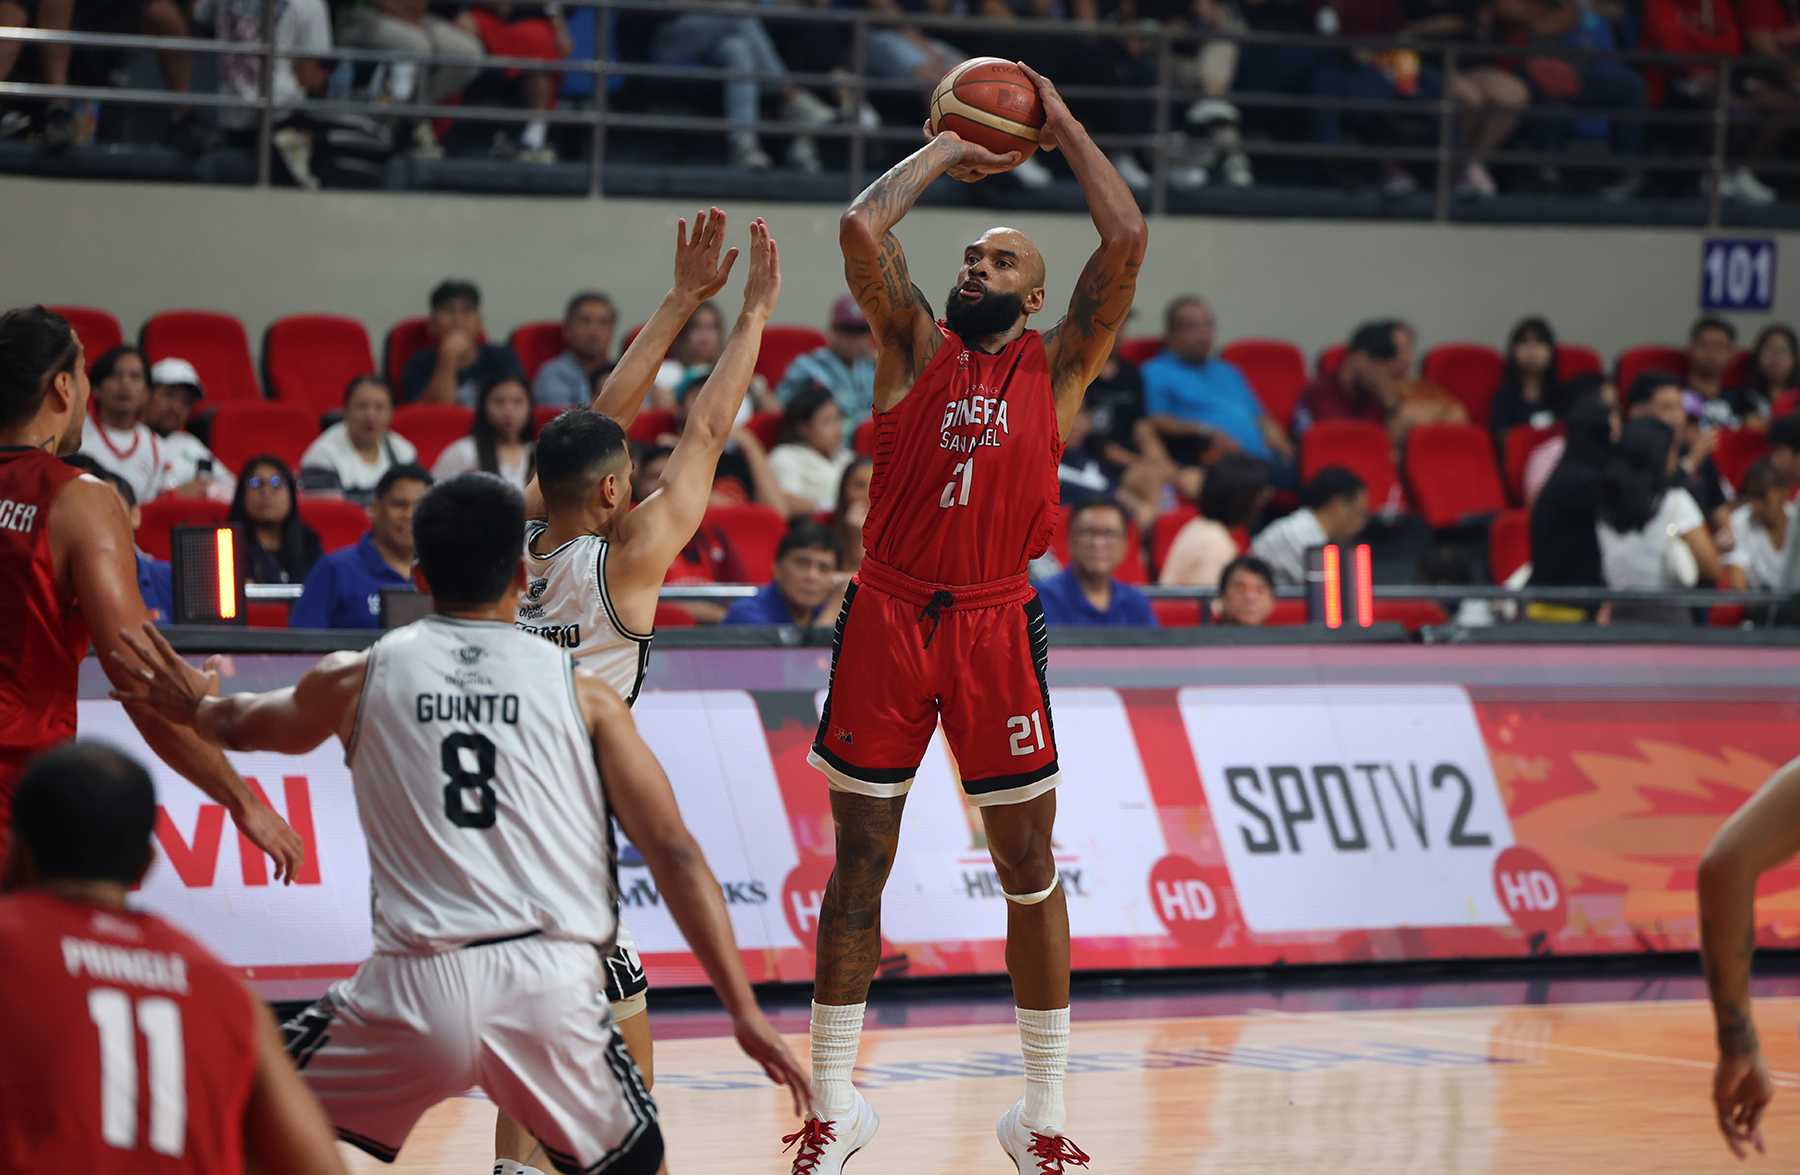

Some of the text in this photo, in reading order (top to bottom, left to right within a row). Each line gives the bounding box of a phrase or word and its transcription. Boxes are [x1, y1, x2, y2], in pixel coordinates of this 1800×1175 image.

[1703, 245, 1770, 304] 101
[938, 456, 974, 509] 21
[416, 693, 519, 724] GUINTO
[1006, 708, 1046, 757] 21
[441, 732, 497, 829] 8
[1156, 879, 1217, 920] HD
[1500, 870, 1559, 911] HD
[86, 985, 188, 1159] 11
